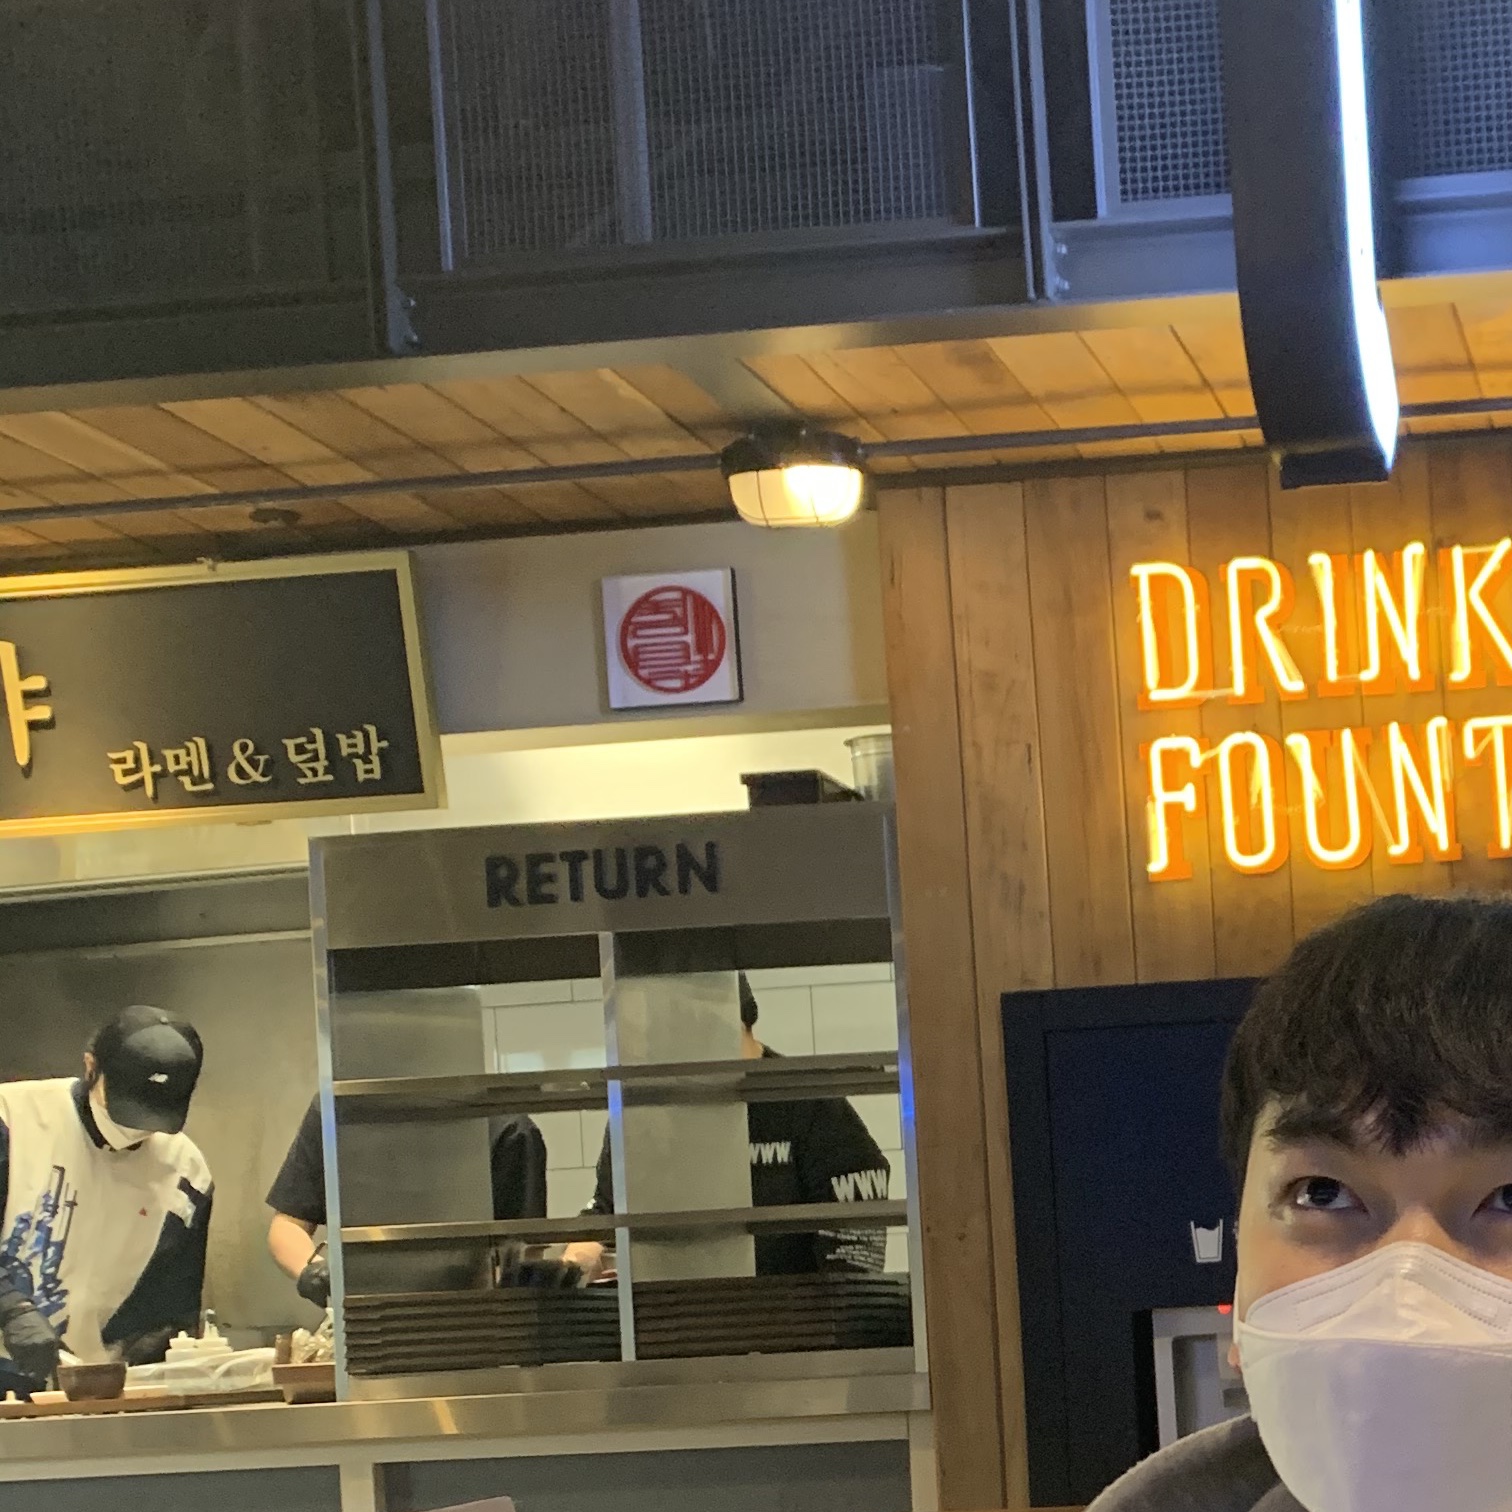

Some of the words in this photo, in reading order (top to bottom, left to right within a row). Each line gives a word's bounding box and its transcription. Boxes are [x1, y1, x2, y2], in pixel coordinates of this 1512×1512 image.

[107, 737, 214, 800] 라멘
[227, 738, 272, 785] &
[282, 724, 389, 783] 덮밥
[485, 840, 719, 908] RETURN
